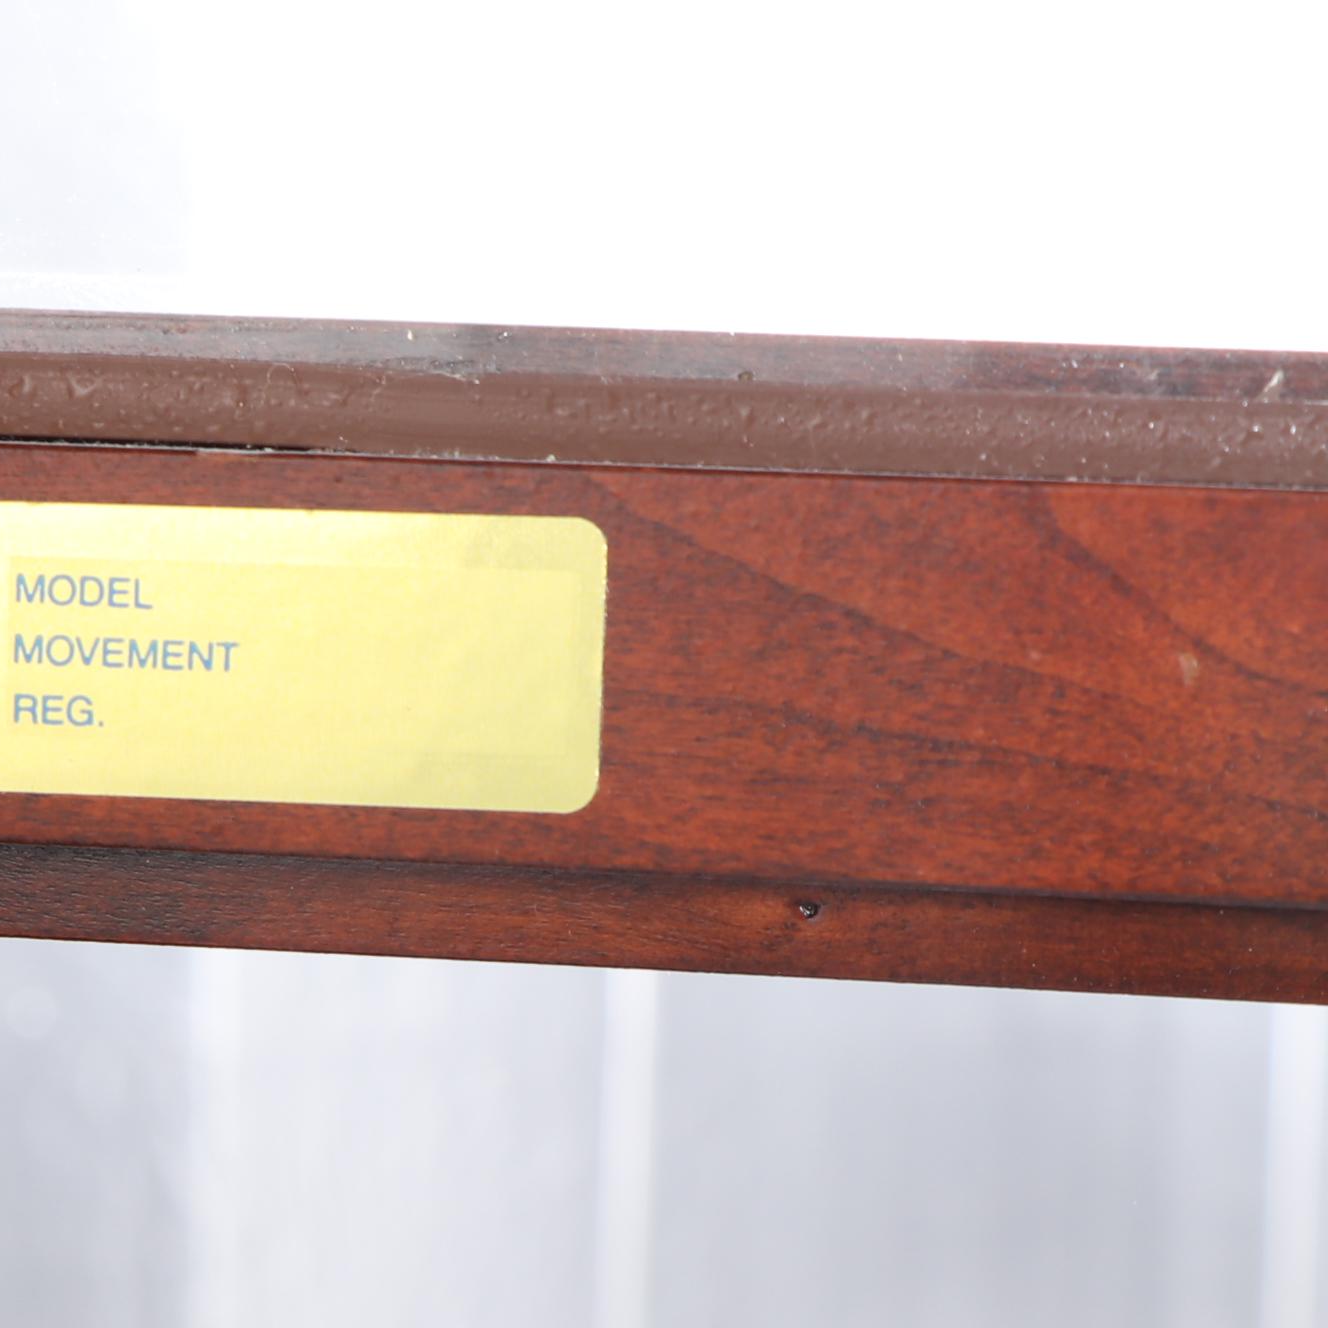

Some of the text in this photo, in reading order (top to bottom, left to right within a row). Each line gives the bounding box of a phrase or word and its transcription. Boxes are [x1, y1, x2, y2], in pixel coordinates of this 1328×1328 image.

[15, 574, 153, 609] MODEL
[13, 634, 239, 672] MOVEMENT
[13, 693, 105, 728] REG.
